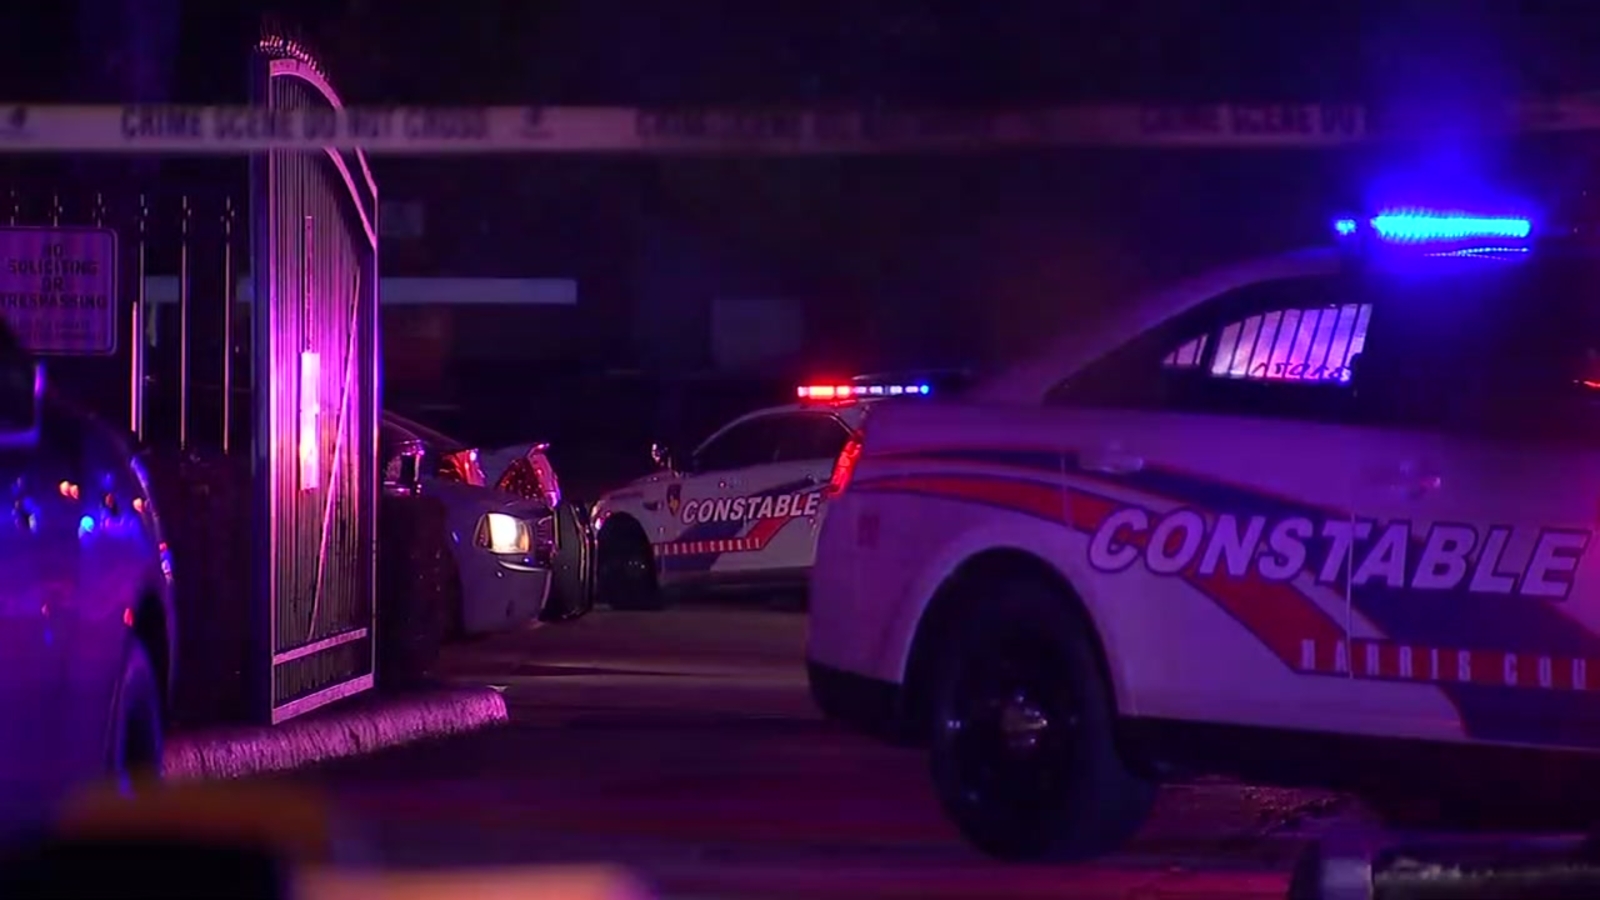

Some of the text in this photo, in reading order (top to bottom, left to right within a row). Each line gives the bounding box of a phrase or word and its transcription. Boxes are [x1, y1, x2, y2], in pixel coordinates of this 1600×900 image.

[121, 108, 202, 140] CRIME
[213, 108, 295, 140] SCENE
[43, 243, 63, 257] NO
[8, 259, 99, 276] SOLICITING
[41, 276, 64, 292] OR
[680, 492, 821, 525] CONSTABLE
[1088, 505, 1592, 601] CONSTABLE
[1299, 638, 1472, 682] HARRIS
